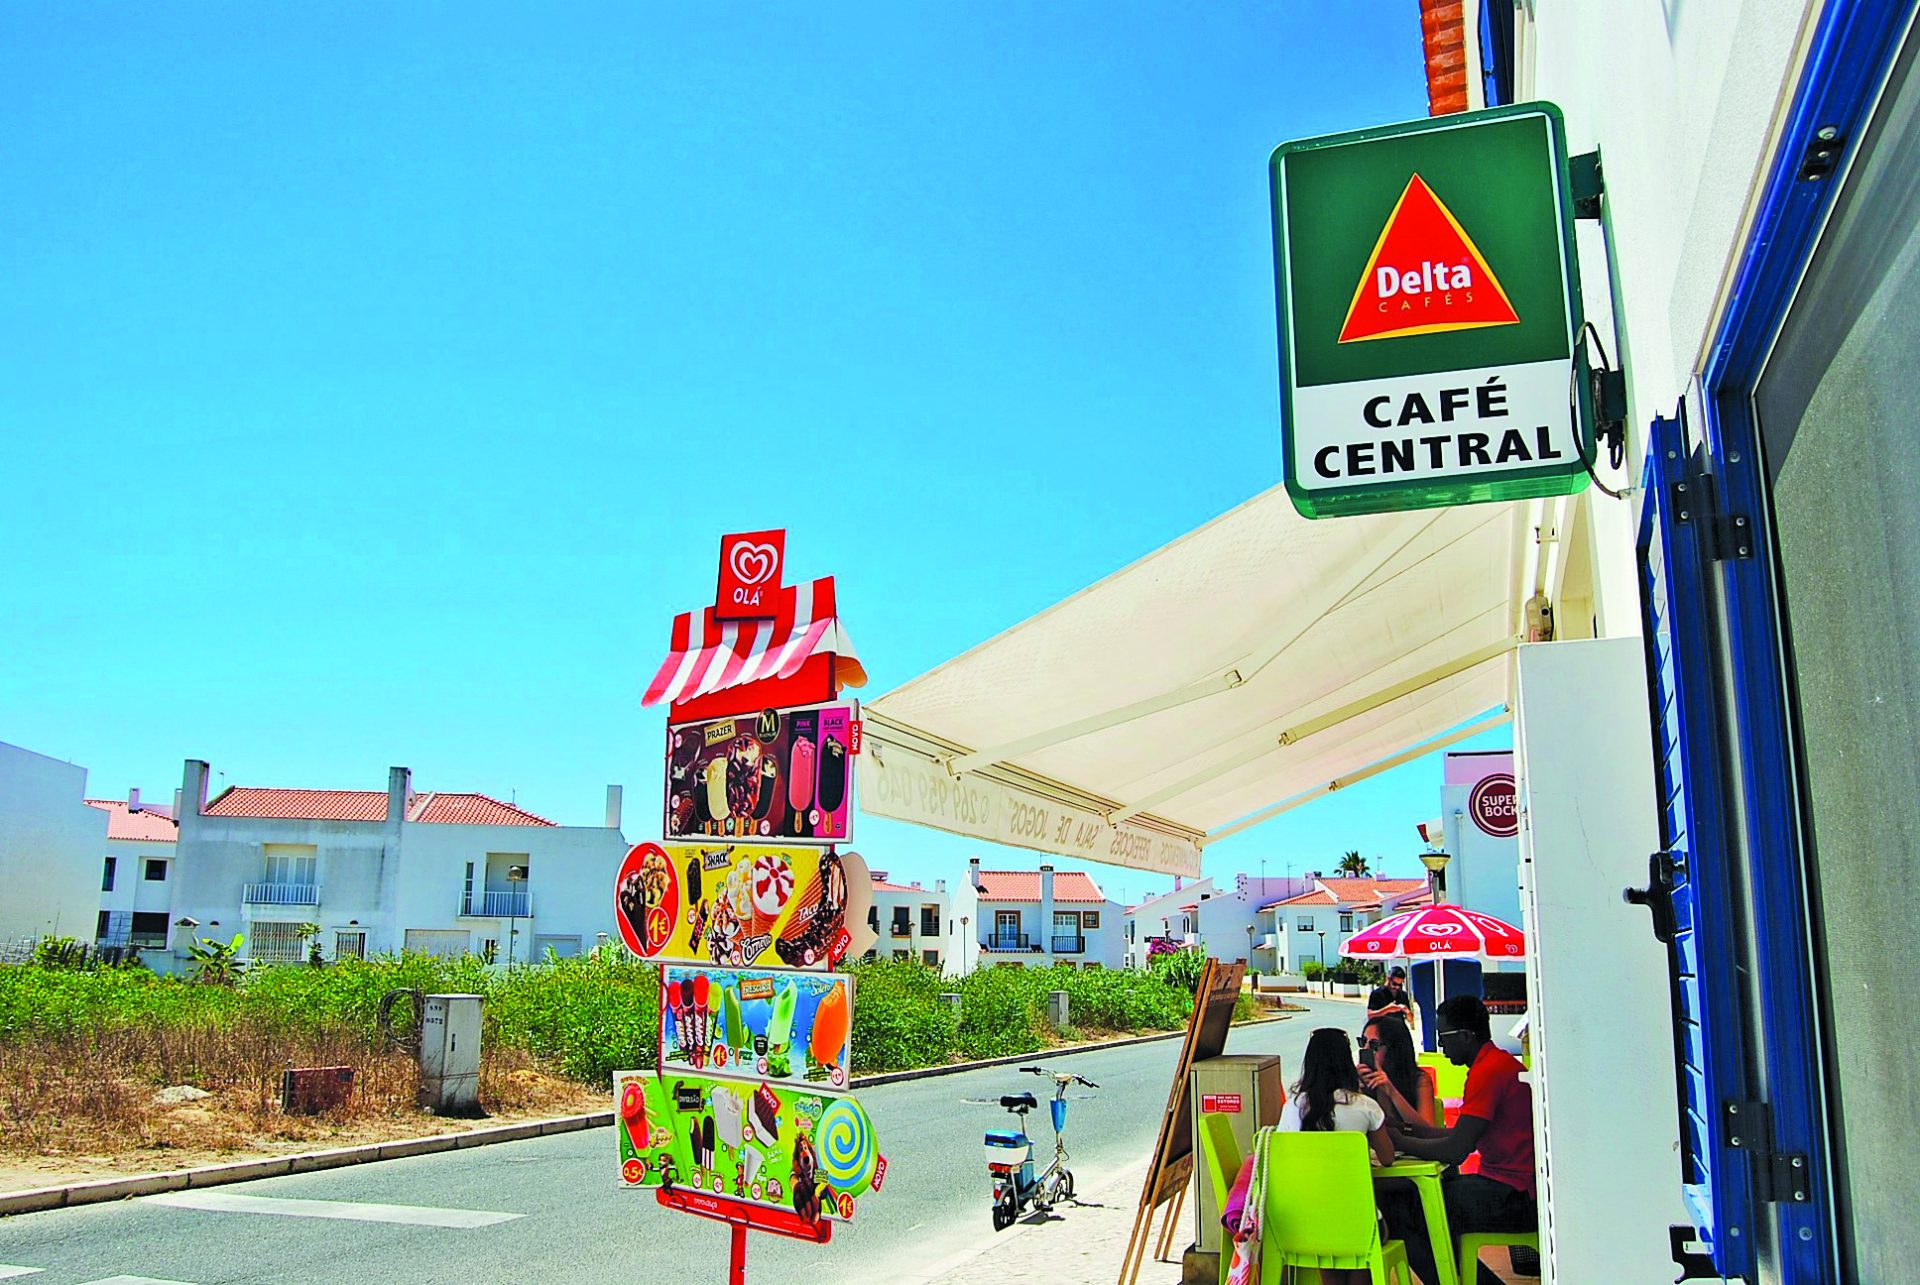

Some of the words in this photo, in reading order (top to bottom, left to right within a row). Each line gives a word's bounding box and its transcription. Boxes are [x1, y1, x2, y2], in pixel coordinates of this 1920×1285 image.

[1376, 261, 1472, 298] Delta
[1378, 292, 1473, 312] CAFÉS
[1363, 376, 1509, 428] CAFÉ
[1314, 426, 1561, 479] CENTRAL
[733, 586, 761, 606] OLÁ
[707, 724, 733, 740] PRAZER
[796, 719, 811, 727] PINK
[823, 718, 843, 727] BLACK
[851, 724, 859, 751] NOVO
[707, 852, 728, 866] SNACK
[799, 904, 819, 920] TACO
[650, 911, 668, 942] 1€
[833, 935, 849, 957] NOVO
[1429, 939, 1452, 950] OLÁ
[714, 1046, 728, 1066] 1€
[761, 1088, 777, 1108] NOVO
[874, 1162, 885, 1188] NOVO
[839, 1196, 853, 1217] 1€
